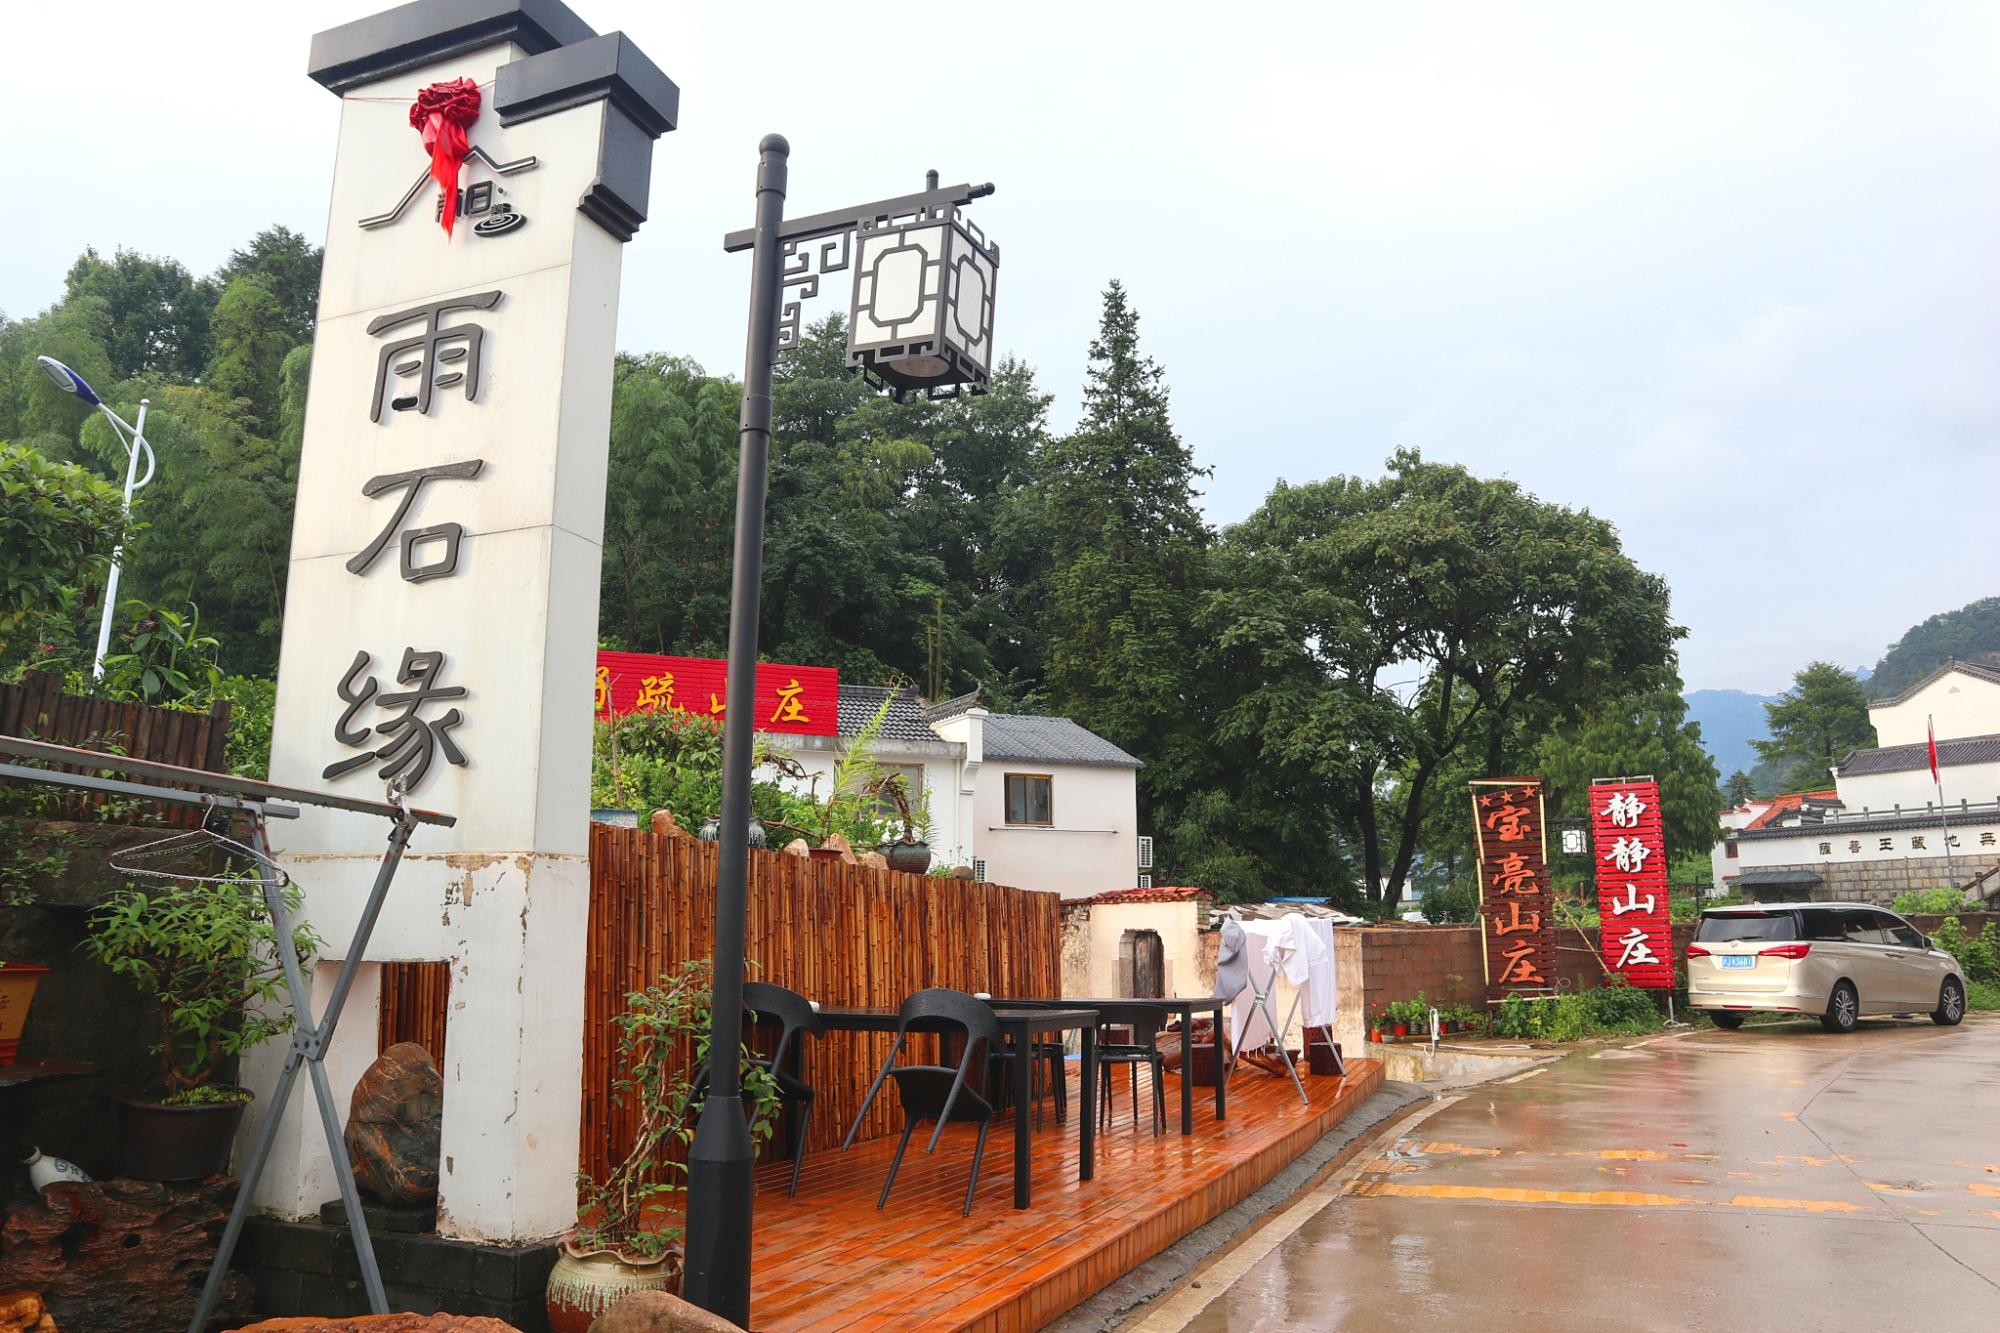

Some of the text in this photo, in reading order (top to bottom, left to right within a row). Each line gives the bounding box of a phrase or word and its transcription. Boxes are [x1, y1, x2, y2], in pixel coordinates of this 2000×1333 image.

[322, 290, 506, 792] 雨石缘
[1486, 804, 1546, 984] 宝亮山庄
[1601, 792, 1660, 969] 静静山庄
